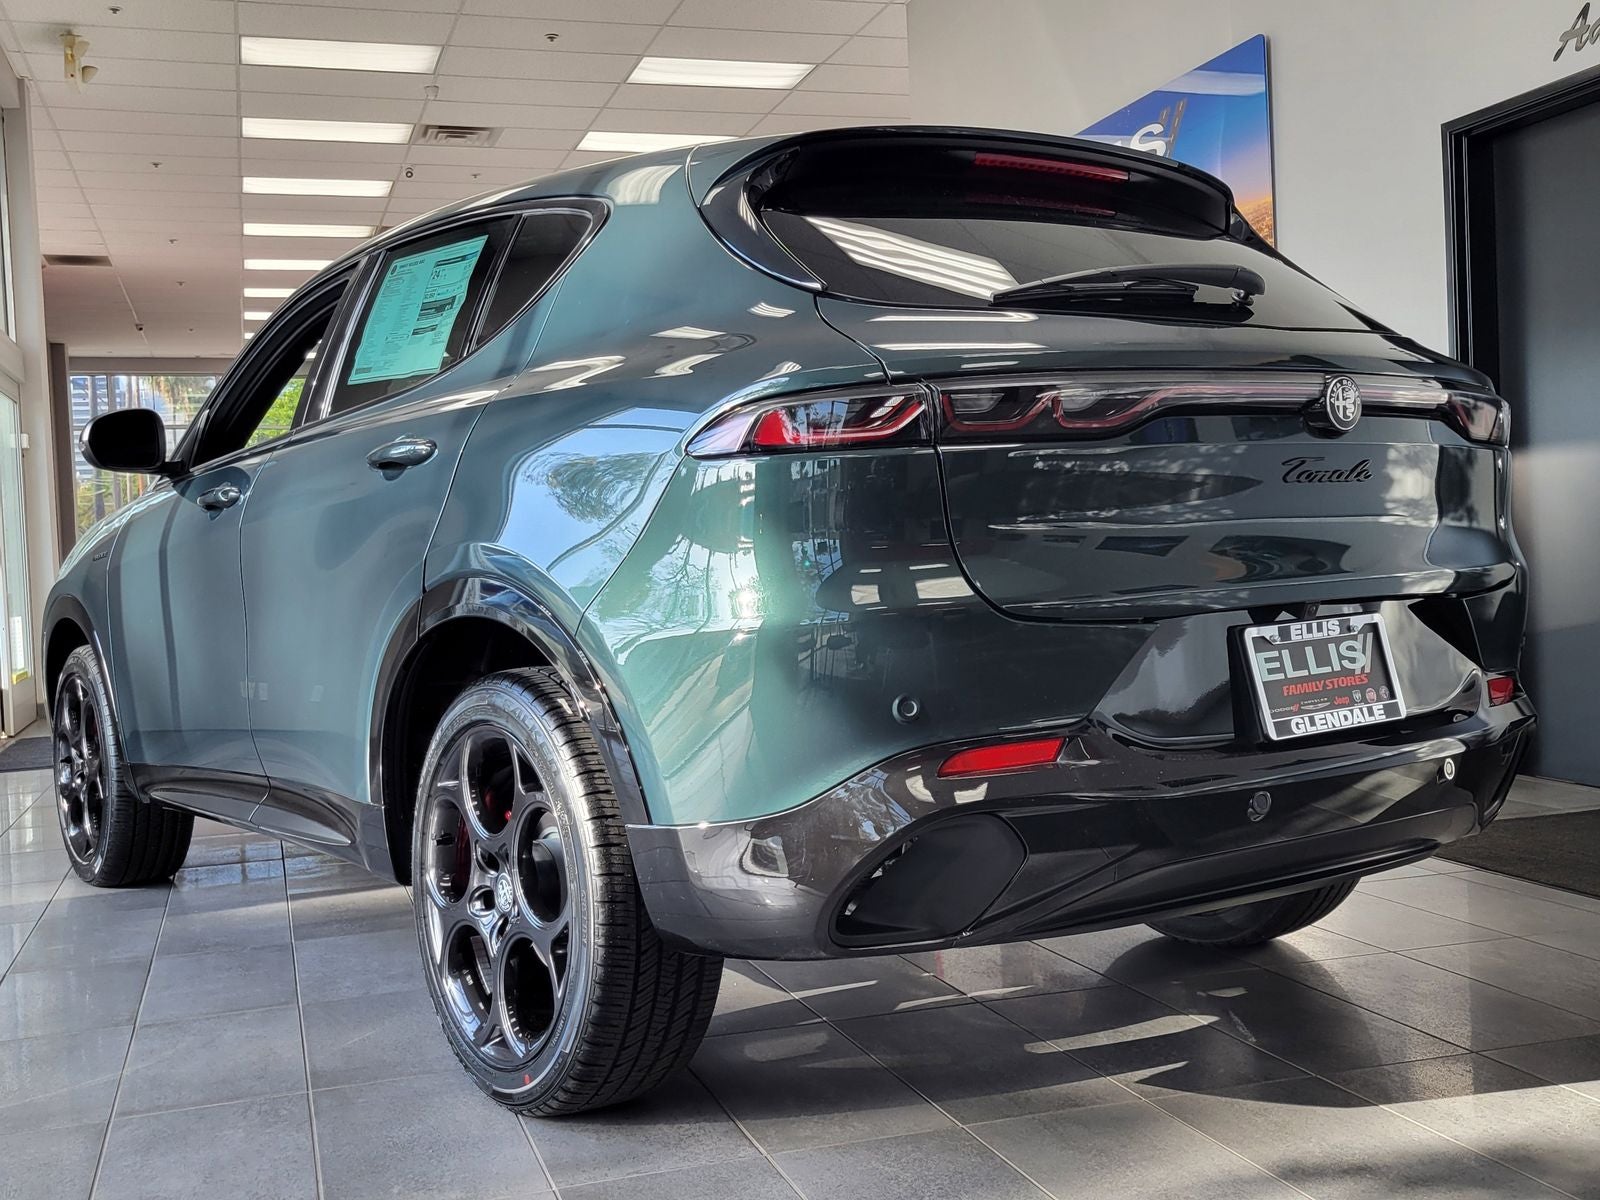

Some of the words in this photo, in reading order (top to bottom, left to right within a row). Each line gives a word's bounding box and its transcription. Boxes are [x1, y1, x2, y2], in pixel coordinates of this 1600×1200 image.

[1330, 382, 1342, 404] ALFA
[1342, 379, 1361, 404] ROMEO
[1281, 456, 1373, 484] Tonale
[1290, 620, 1341, 641] ELLIS
[1256, 639, 1367, 682] ELLIS
[1282, 679, 1325, 697] FAMILY
[1325, 674, 1369, 691] STORES
[1333, 695, 1351, 706] Jeep
[1290, 704, 1387, 735] GLENDALE
